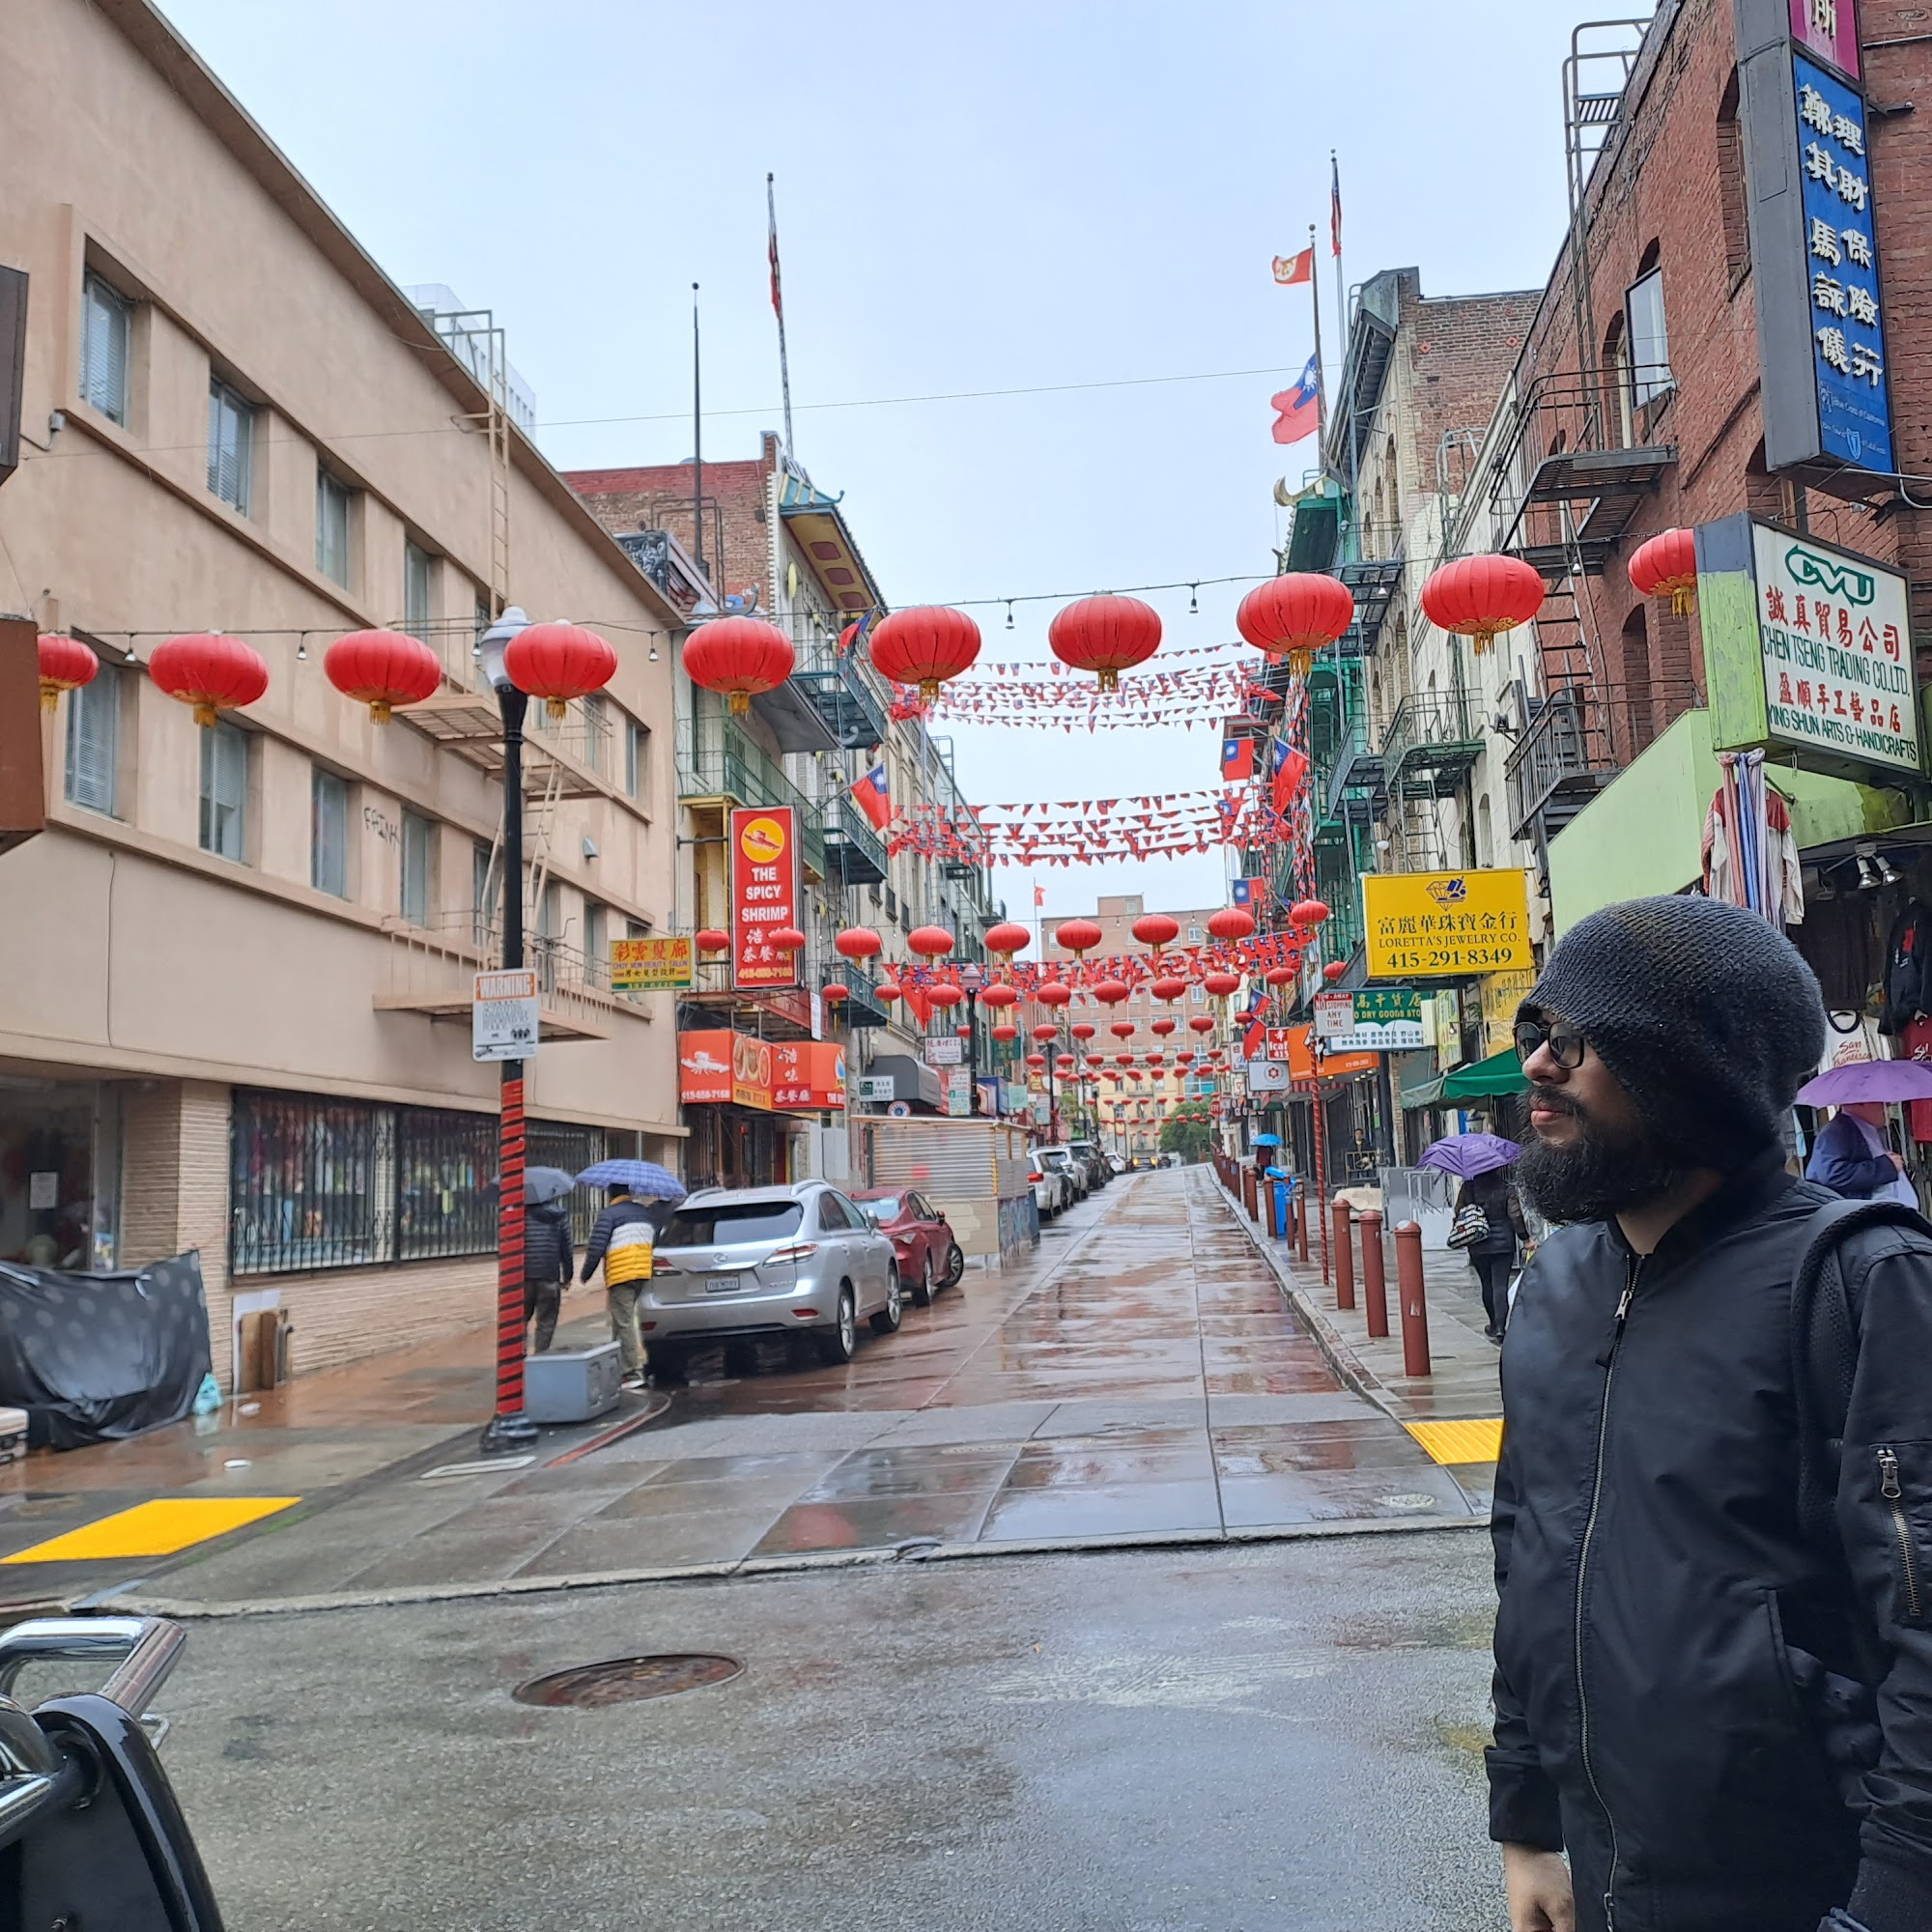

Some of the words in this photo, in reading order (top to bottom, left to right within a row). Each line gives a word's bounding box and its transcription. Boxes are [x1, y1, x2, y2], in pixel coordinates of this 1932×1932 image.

[1833, 115, 1883, 386] 理財保險行
[1762, 624, 1791, 663] CHEN
[1791, 634, 1826, 673] TSENG
[1827, 645, 1870, 686] TRADING
[1779, 671, 1901, 734] 盈順手工藝品店
[1791, 709, 1820, 737] SHUN
[1822, 719, 1845, 743] ARTS
[1845, 724, 1855, 745] &
[1855, 726, 1917, 762] HANDICRAFTS
[752, 867, 777, 881] THE
[746, 885, 781, 900] SPICY
[742, 906, 788, 922] SHRIMP
[1378, 911, 1519, 935] 富麗華珠寶金行
[1378, 935, 1443, 949] LORETTA'S
[1443, 932, 1496, 948] JEWELRY
[1500, 932, 1520, 943] CO.
[1387, 948, 1512, 969] 415-291-8349
[1315, 999, 1326, 1010] NO
[1328, 1001, 1351, 1009] STOPPING
[1361, 1010, 1377, 1019] DRY
[1378, 1009, 1405, 1019] GOODS
[1327, 1019, 1343, 1028] TIME
[1838, 1040, 1862, 1054] San
